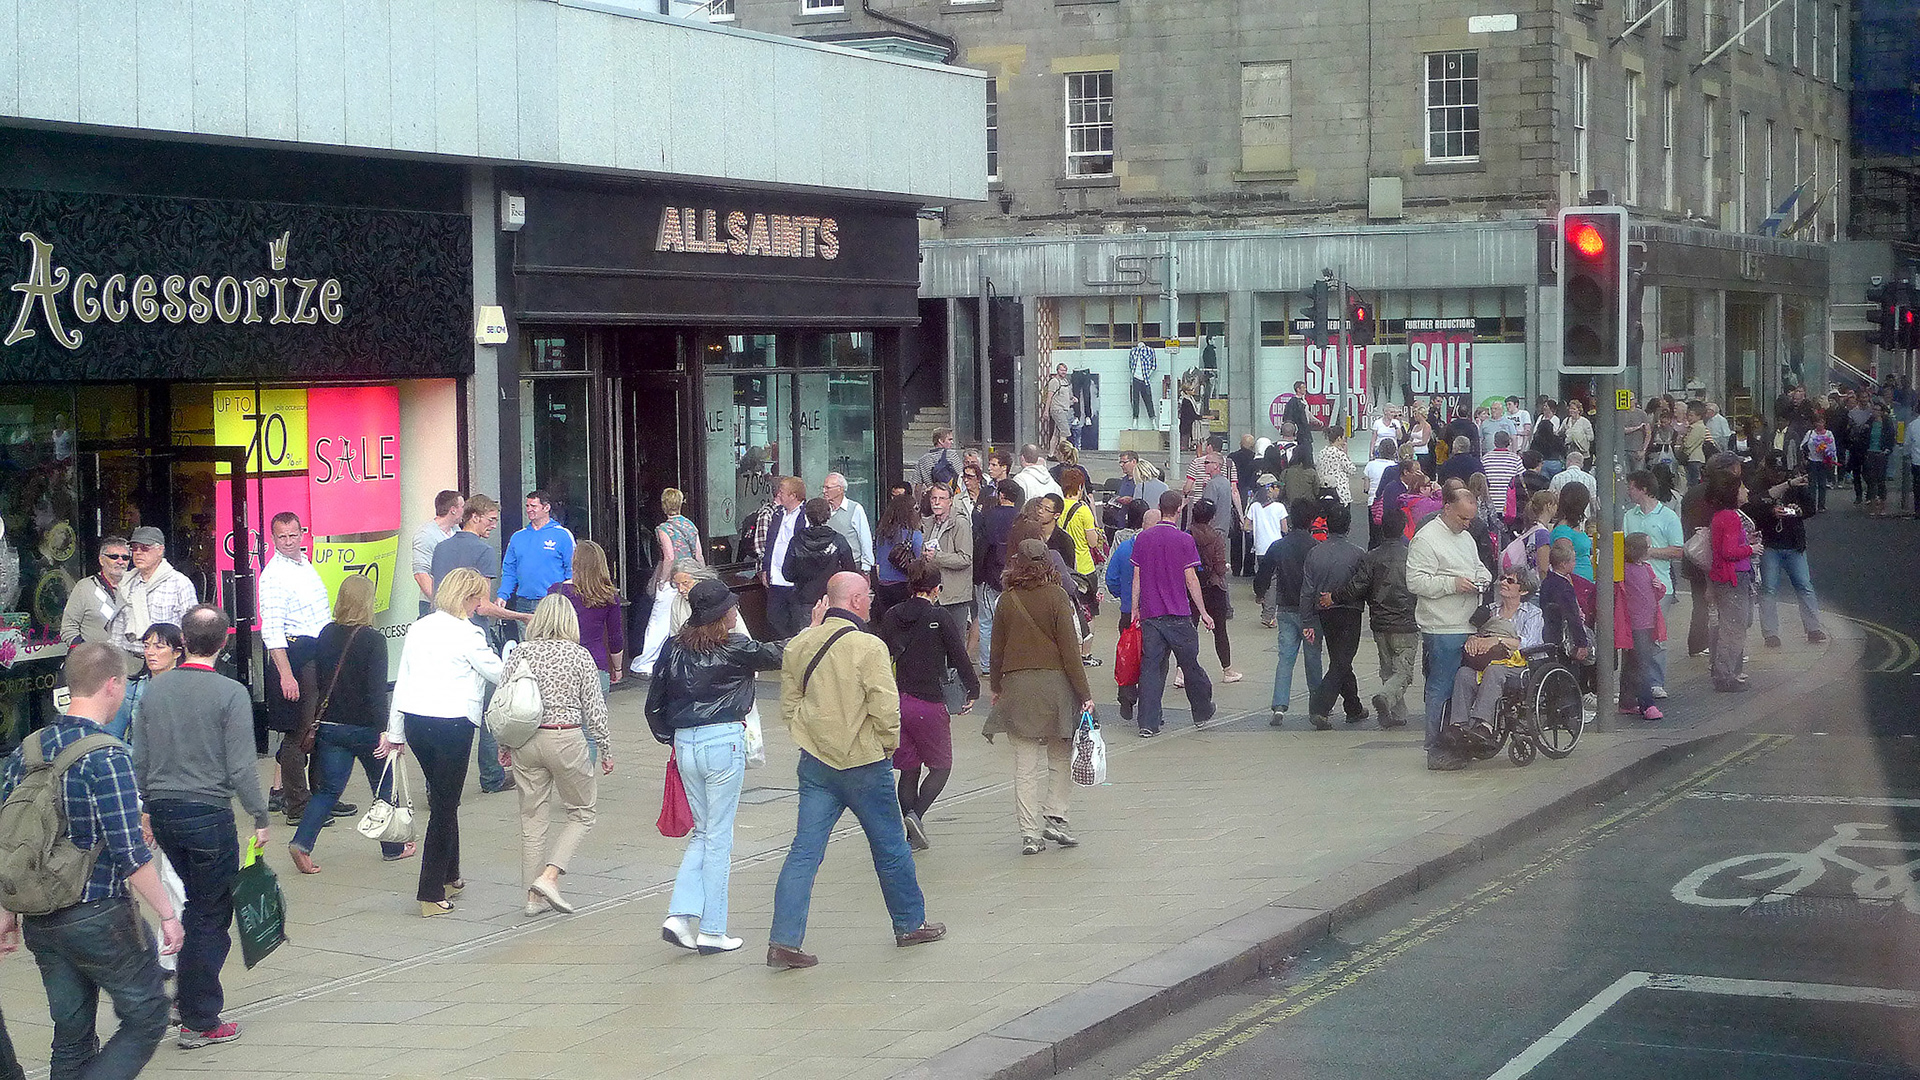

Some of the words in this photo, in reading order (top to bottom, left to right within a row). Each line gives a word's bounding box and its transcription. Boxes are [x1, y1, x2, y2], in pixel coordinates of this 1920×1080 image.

[656, 207, 840, 260] ALLSAINTS
[4, 231, 343, 349] Accessorize
[1405, 319, 1433, 330] FURTHER
[1435, 318, 1476, 329] REDUCTIONS
[1306, 344, 1364, 395] SALE
[1410, 342, 1471, 394] SALE
[215, 397, 231, 412] UP
[235, 396, 251, 412] TO
[1322, 405, 1330, 416] TO
[315, 435, 395, 484] SALE
[315, 548, 333, 563] UP
[338, 548, 355, 563] TO
